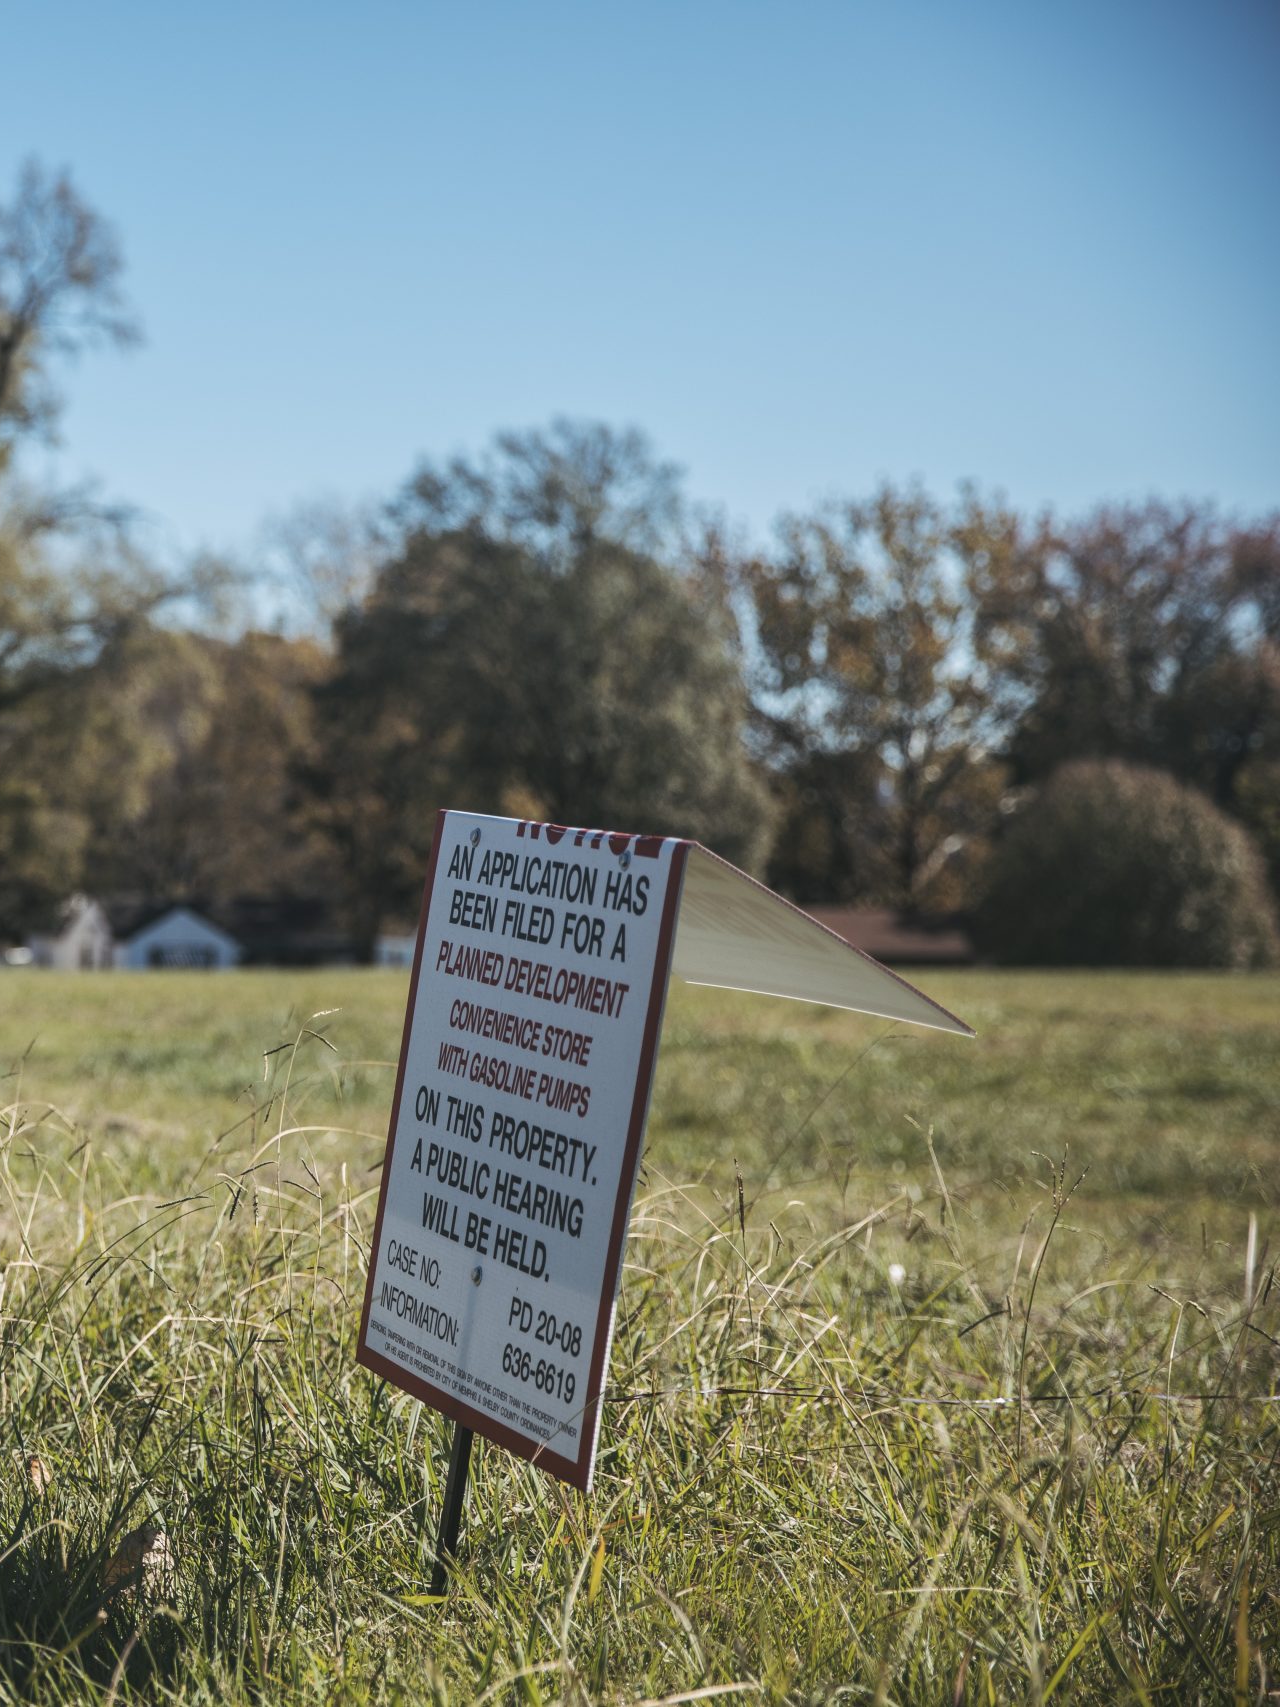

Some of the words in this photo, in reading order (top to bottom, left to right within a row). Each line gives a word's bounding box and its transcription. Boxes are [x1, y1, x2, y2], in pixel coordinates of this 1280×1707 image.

[447, 844, 475, 881] AN
[477, 850, 598, 906] APPLICATION
[603, 870, 650, 916] HAS
[449, 889, 498, 932] BEEN
[502, 899, 555, 945] FILED
[560, 911, 606, 957] FOR
[610, 923, 626, 962] A
[436, 940, 504, 986] PLANNED
[504, 957, 629, 1019] DEVELOPMENT
[449, 999, 543, 1052] CONVENIENCE
[541, 1025, 593, 1067] STORE
[438, 1042, 470, 1078] WITH
[470, 1052, 538, 1100] GASOLINE
[536, 1074, 591, 1118] PUMPS
[415, 1085, 441, 1126] ON
[446, 1096, 484, 1142] THIS
[489, 1112, 597, 1186] PROPERTY.
[410, 1138, 422, 1173] A
[426, 1143, 490, 1199] PUBLIC
[493, 1169, 584, 1238] HEARING
[387, 1240, 418, 1277] CASE
[420, 1255, 442, 1289] NO:
[422, 1192, 459, 1243] WILL
[464, 1212, 491, 1255] BE
[493, 1224, 549, 1282] HELD.
[380, 1281, 459, 1347] INFORMATION:
[508, 1296, 532, 1333] PD
[535, 1310, 582, 1357] 20-08
[385, 1342, 391, 1351] OR
[397, 1349, 409, 1362] AGENT
[414, 1358, 436, 1378] PROHIBITED
[435, 1370, 441, 1380] BY
[442, 1374, 452, 1385] CITY
[452, 1380, 459, 1389] OF
[459, 1382, 477, 1402] MEMPHIS
[483, 1396, 500, 1413] SHELBY
[500, 1406, 519, 1421] COUNTY
[406, 1339, 416, 1352] WITH
[416, 1345, 422, 1355] OR
[422, 1349, 439, 1366] REMOVAL
[440, 1359, 447, 1368] OF
[447, 1363, 456, 1375] THIS
[456, 1367, 467, 1380] SIGN
[467, 1373, 474, 1383] BY
[474, 1378, 492, 1393] ANYONE
[492, 1387, 508, 1402] OTHER
[509, 1395, 521, 1408] THAN
[522, 1402, 531, 1415] THE
[531, 1407, 558, 1428] PROPERTY
[558, 1420, 577, 1438] OWNER
[502, 1343, 576, 1404] 636-6619
